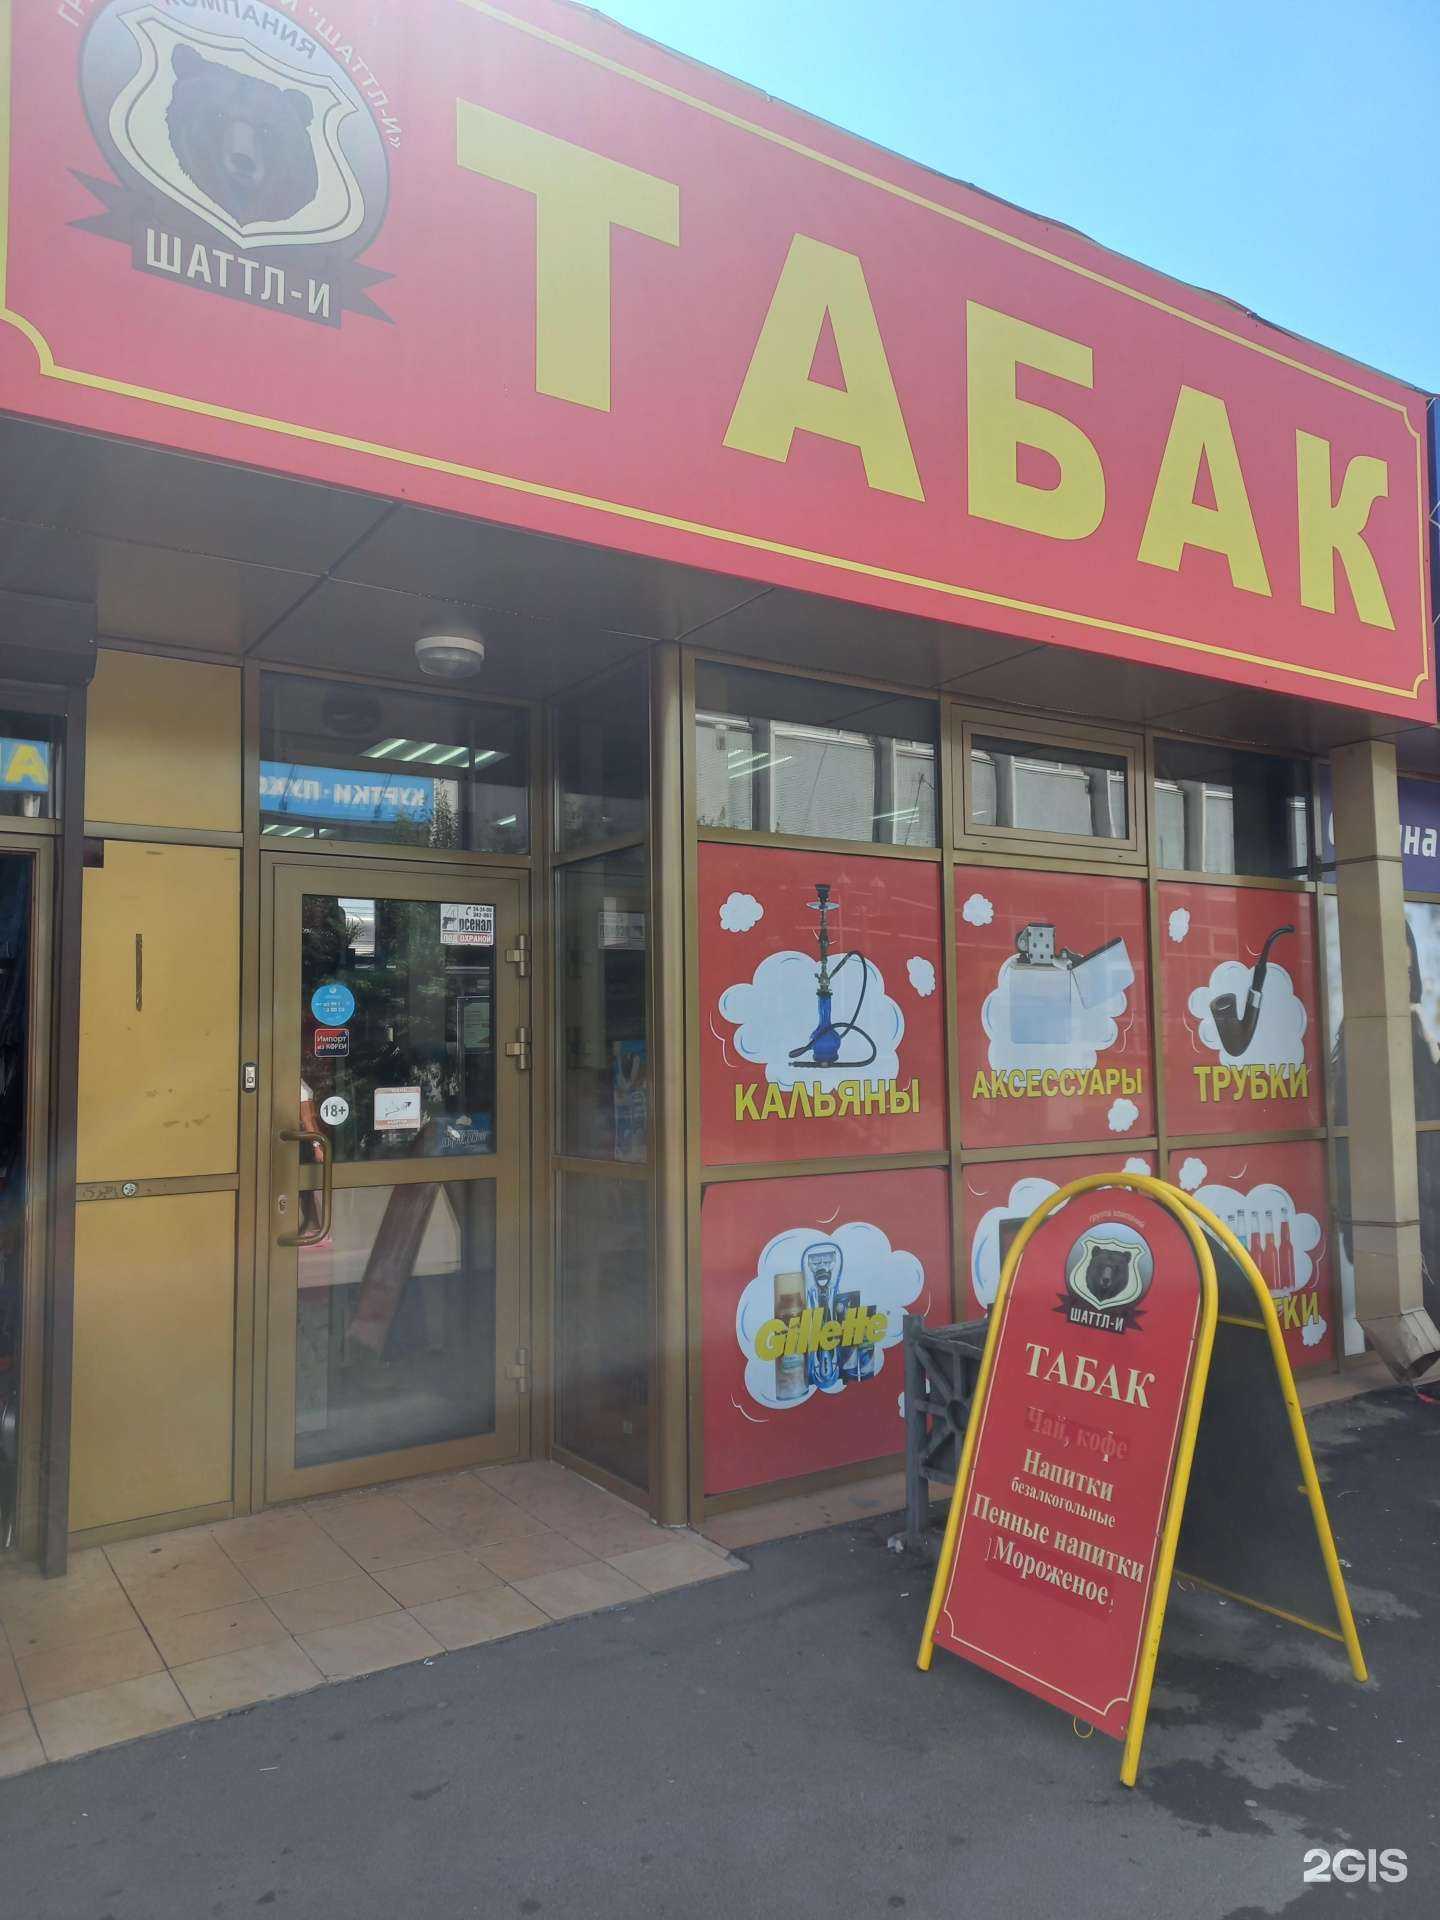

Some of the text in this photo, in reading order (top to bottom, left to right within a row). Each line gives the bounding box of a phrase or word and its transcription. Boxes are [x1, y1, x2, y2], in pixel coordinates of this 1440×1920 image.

[145, 228, 331, 318] ШАТТЛ-И
[457, 97, 1396, 631] ТАБАК
[317, 1035, 347, 1044] Импорт
[734, 1078, 921, 1121] КАЛЬЯНЫ
[972, 1067, 1143, 1100] АКСЕССУАРЫ
[1193, 1063, 1310, 1103] ТРУБКИ
[324, 1104, 346, 1117] 18+
[754, 1306, 888, 1362] Gillette
[1070, 1307, 1124, 1332] ШАТТЛ-И
[1026, 1343, 1155, 1408] ТАБАК
[1027, 1406, 1128, 1463] Чай, кофе
[1011, 1476, 1116, 1528] безалкогольные
[1023, 1448, 1114, 1502] Напитки
[971, 1493, 1145, 1583] Пенные напитки
[993, 1535, 1109, 1606] Мороженое
